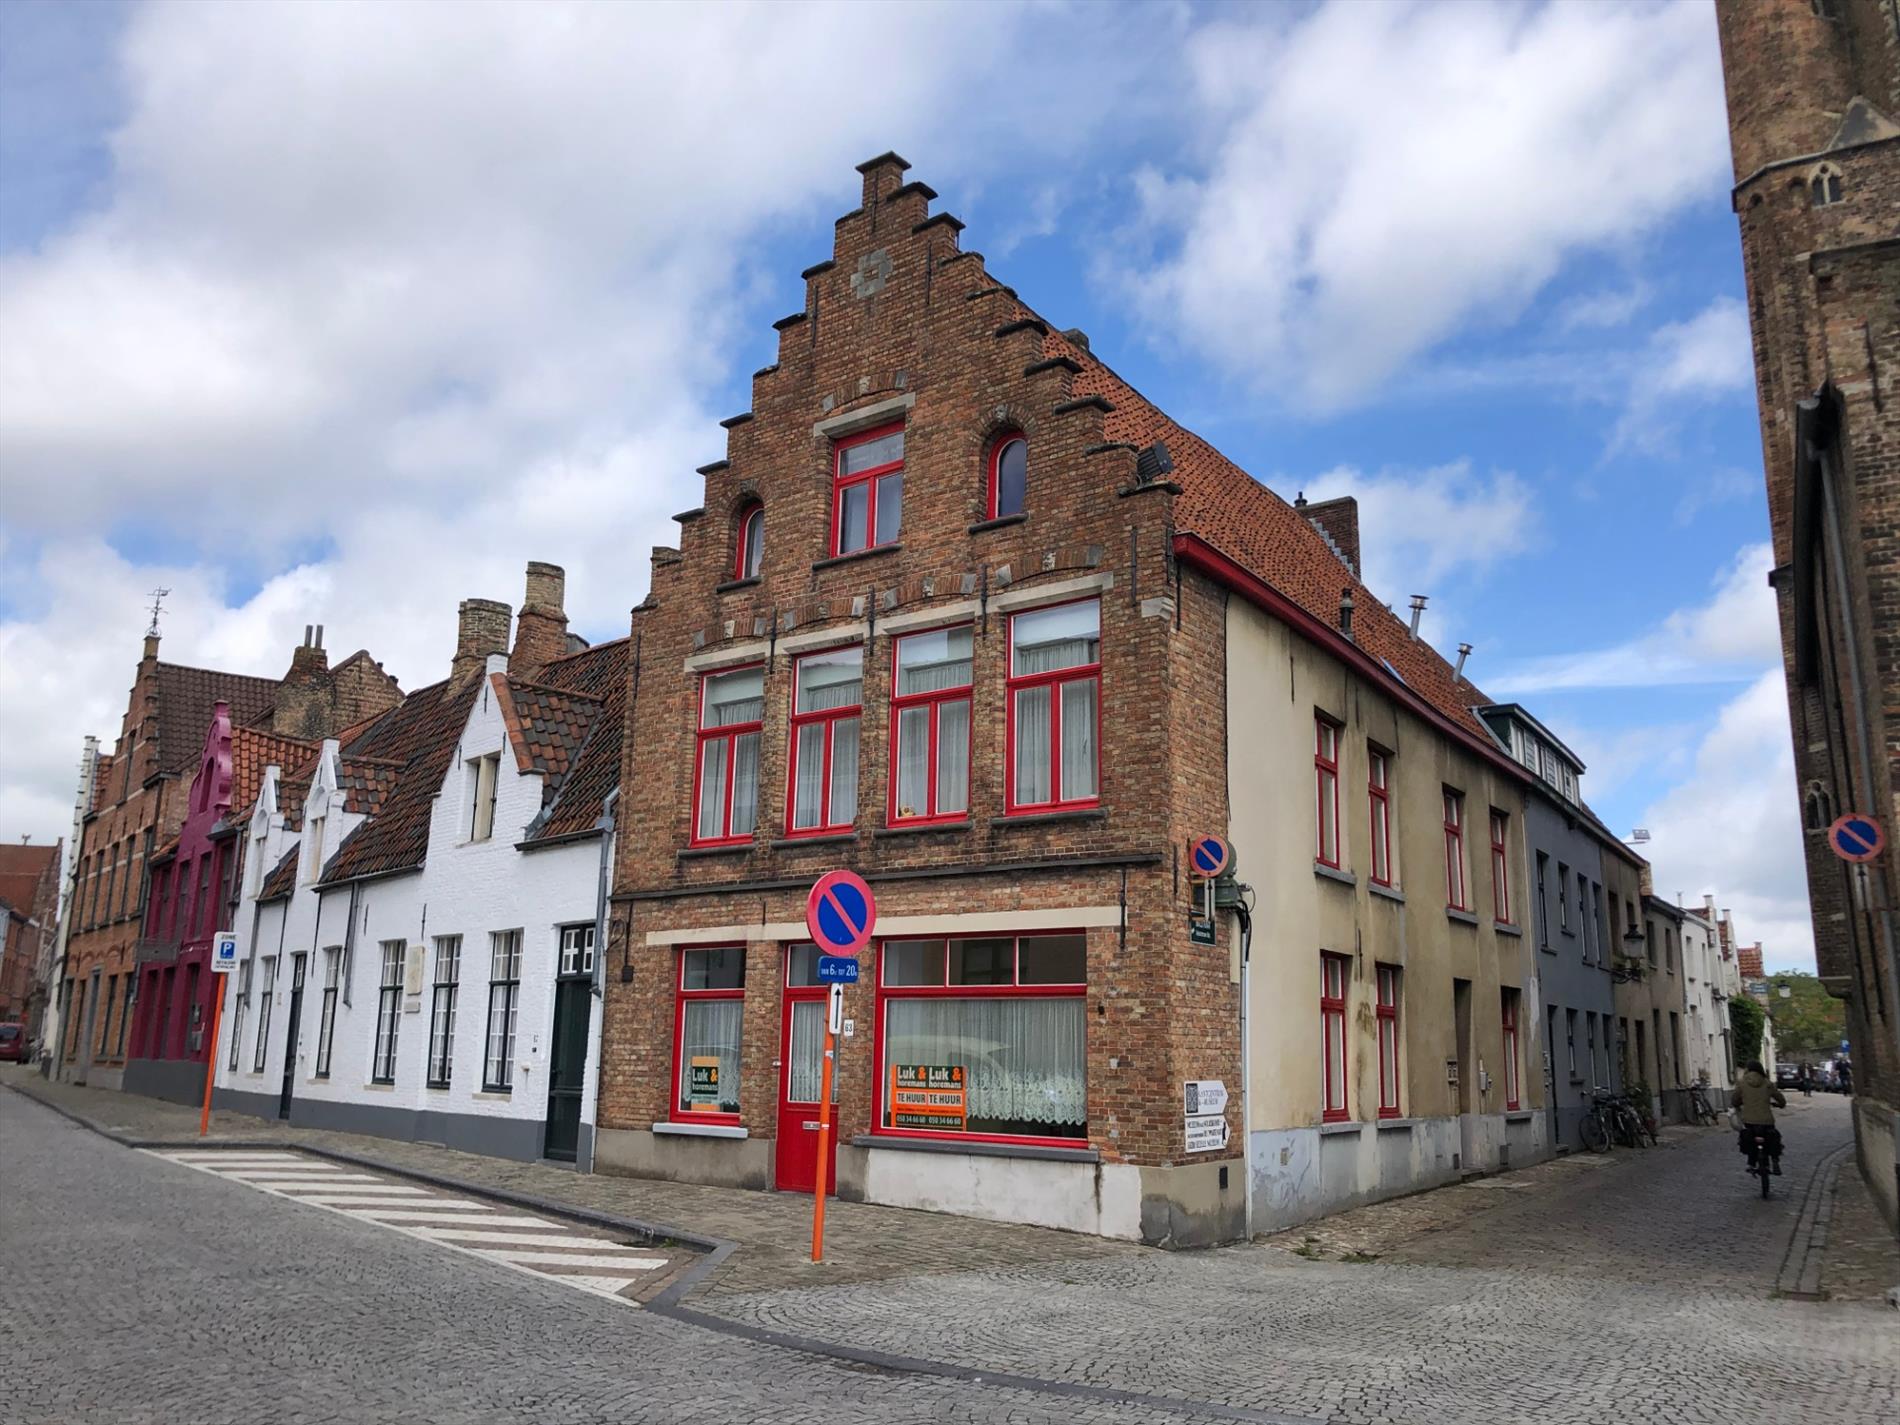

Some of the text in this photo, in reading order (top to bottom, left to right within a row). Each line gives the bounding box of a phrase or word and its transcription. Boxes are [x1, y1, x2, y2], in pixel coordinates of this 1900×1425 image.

[224, 944, 232, 954] P
[692, 1068, 718, 1083] Luk &
[897, 1066, 926, 1080] Luk &
[929, 1067, 962, 1081] Luk &
[897, 1093, 926, 1103] TE HUUR
[929, 1094, 961, 1104] TE HUUR
